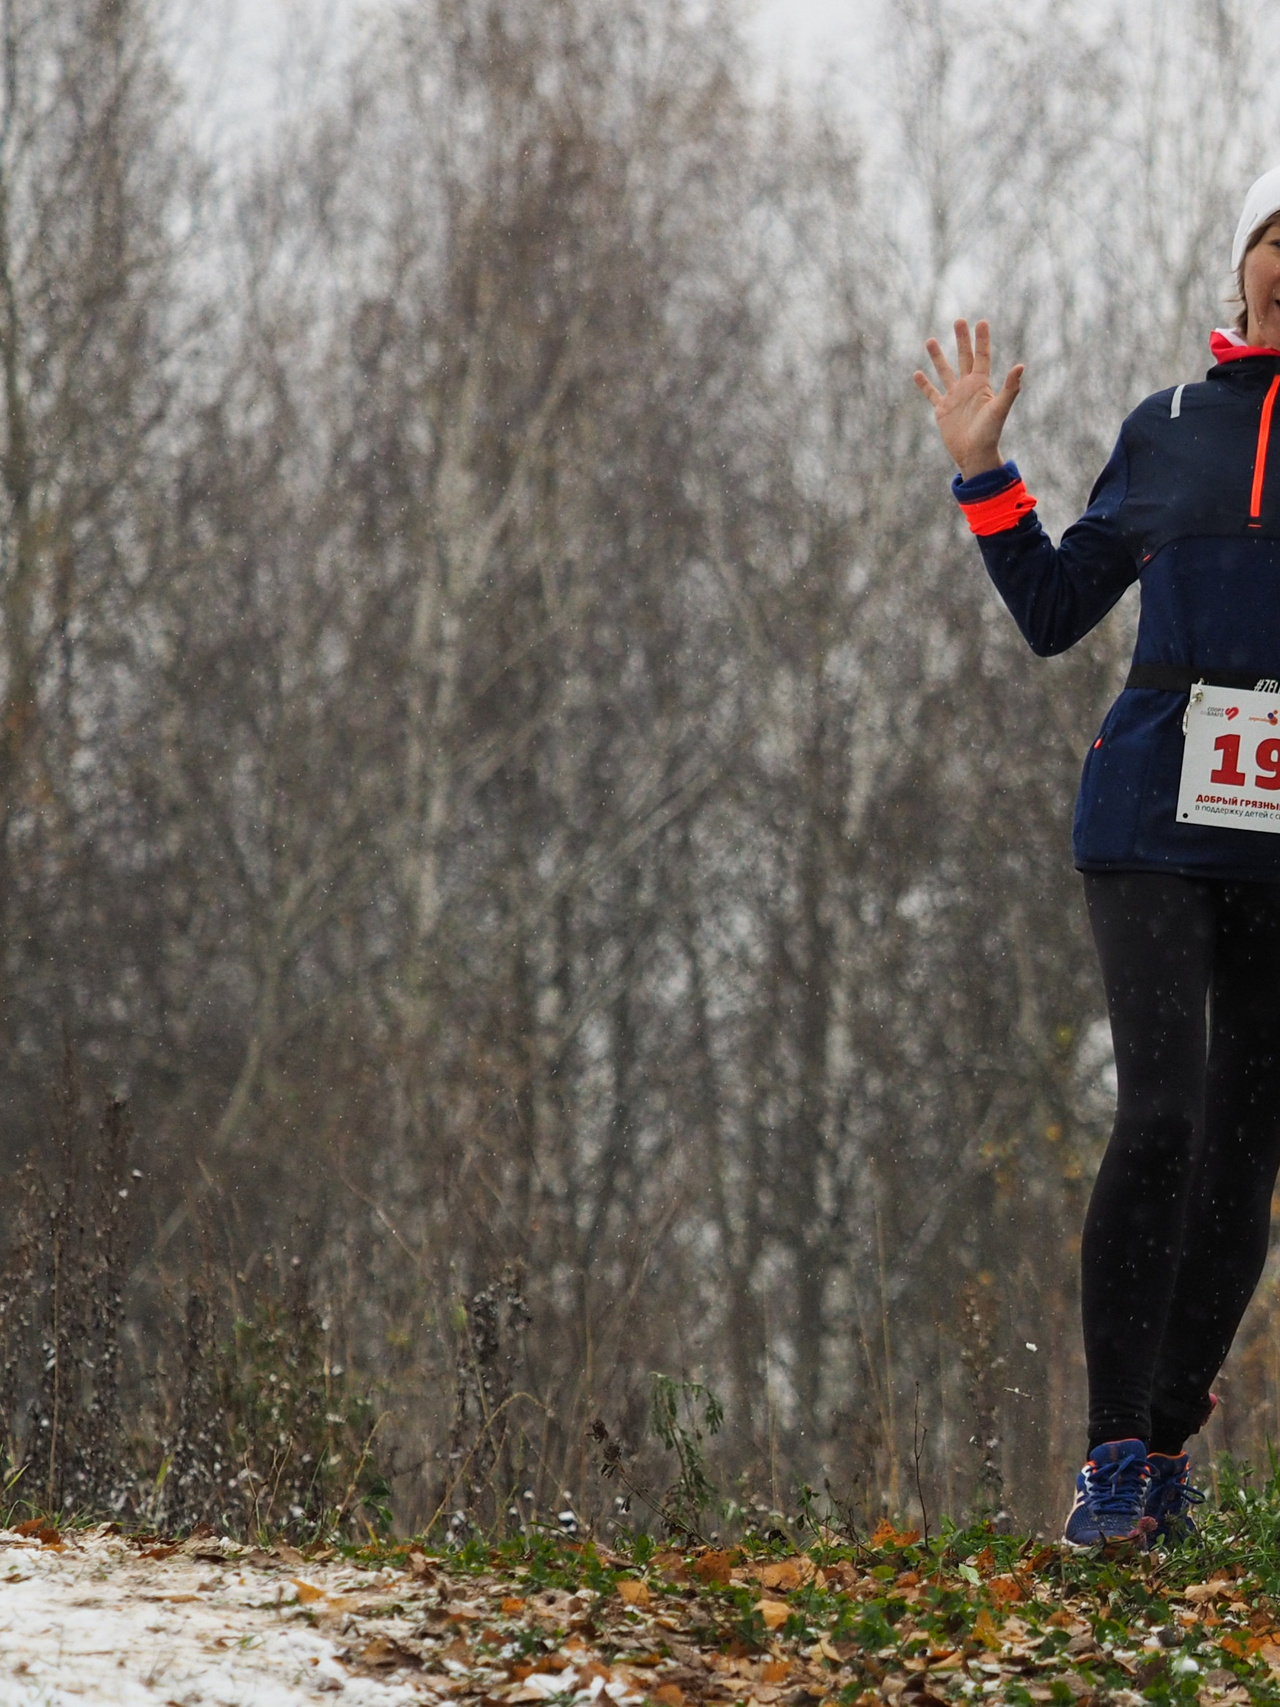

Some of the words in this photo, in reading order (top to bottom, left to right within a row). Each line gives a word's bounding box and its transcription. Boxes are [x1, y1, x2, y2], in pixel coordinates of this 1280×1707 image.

[1195, 794, 1238, 806] ДОБРЫЙ
[1201, 805, 1243, 817] поддержку
[1244, 810, 1268, 819] детей
